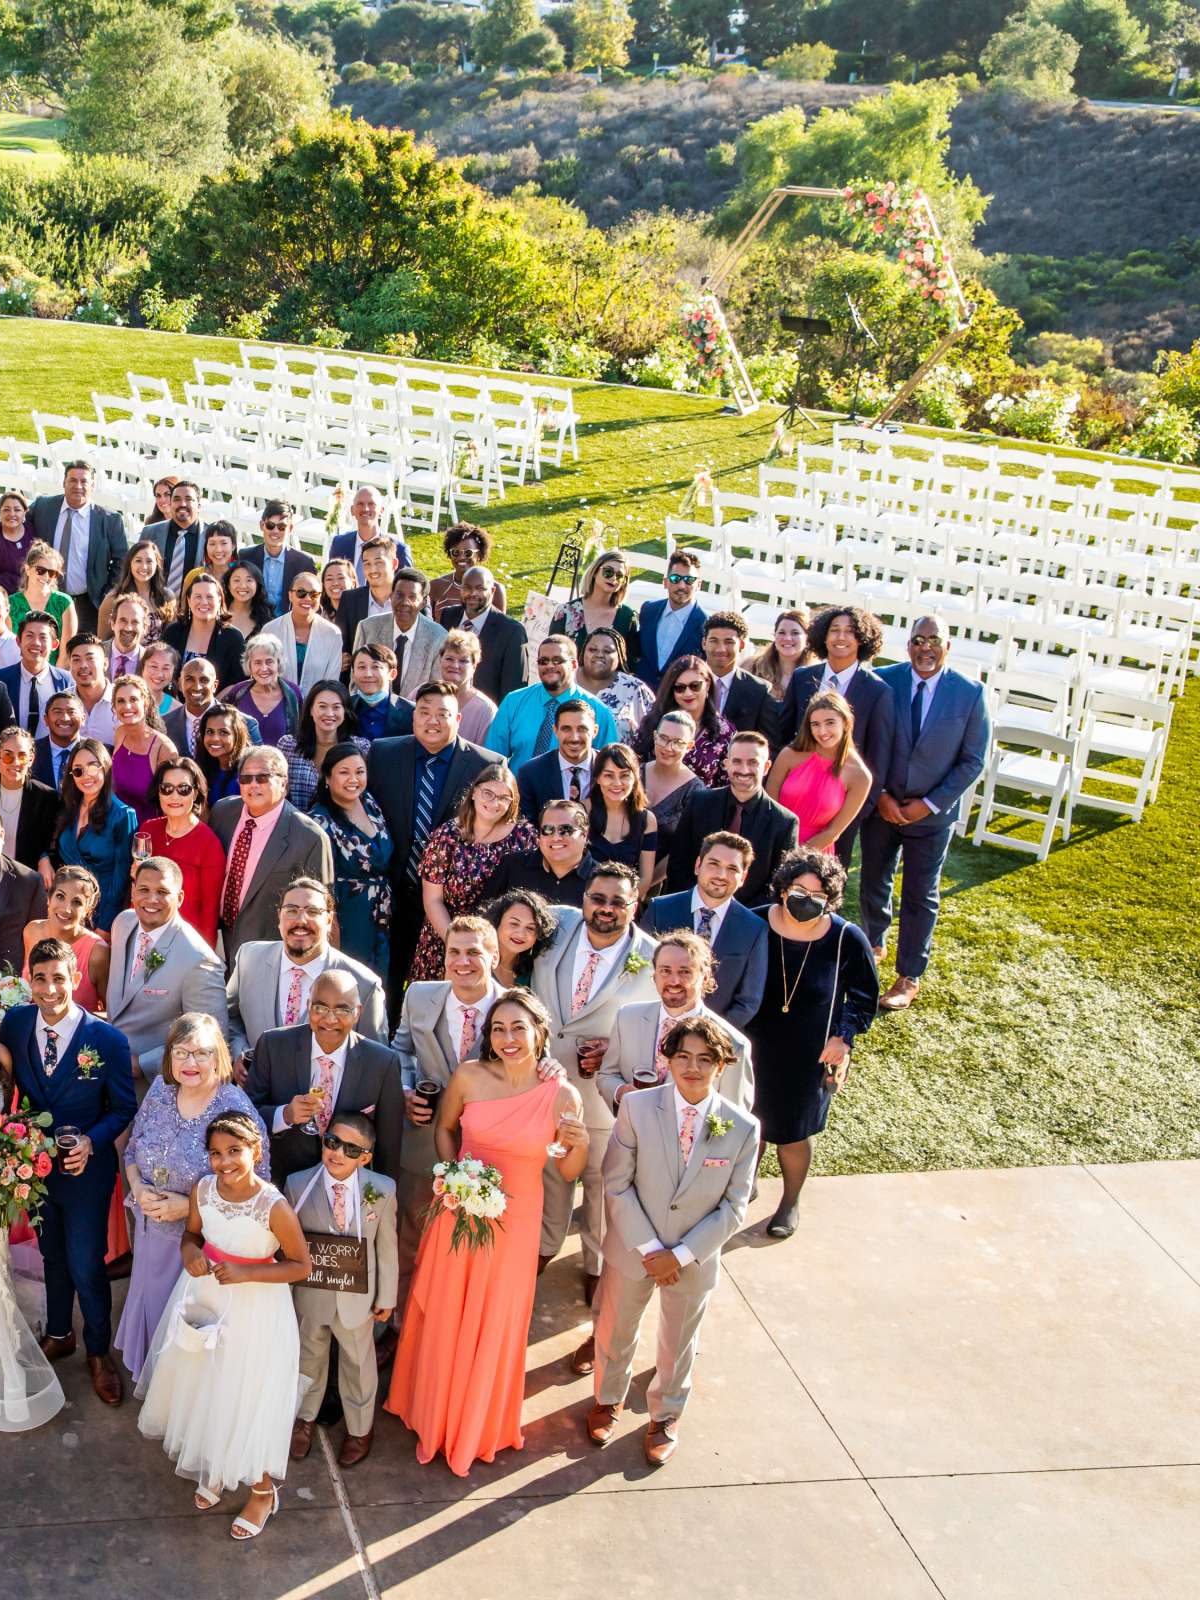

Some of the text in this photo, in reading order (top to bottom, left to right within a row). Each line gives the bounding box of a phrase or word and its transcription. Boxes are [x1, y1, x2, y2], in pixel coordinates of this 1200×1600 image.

[316, 1242, 360, 1257] WORRY
[310, 1254, 340, 1268] ADIES,
[327, 1273, 355, 1290] single!
